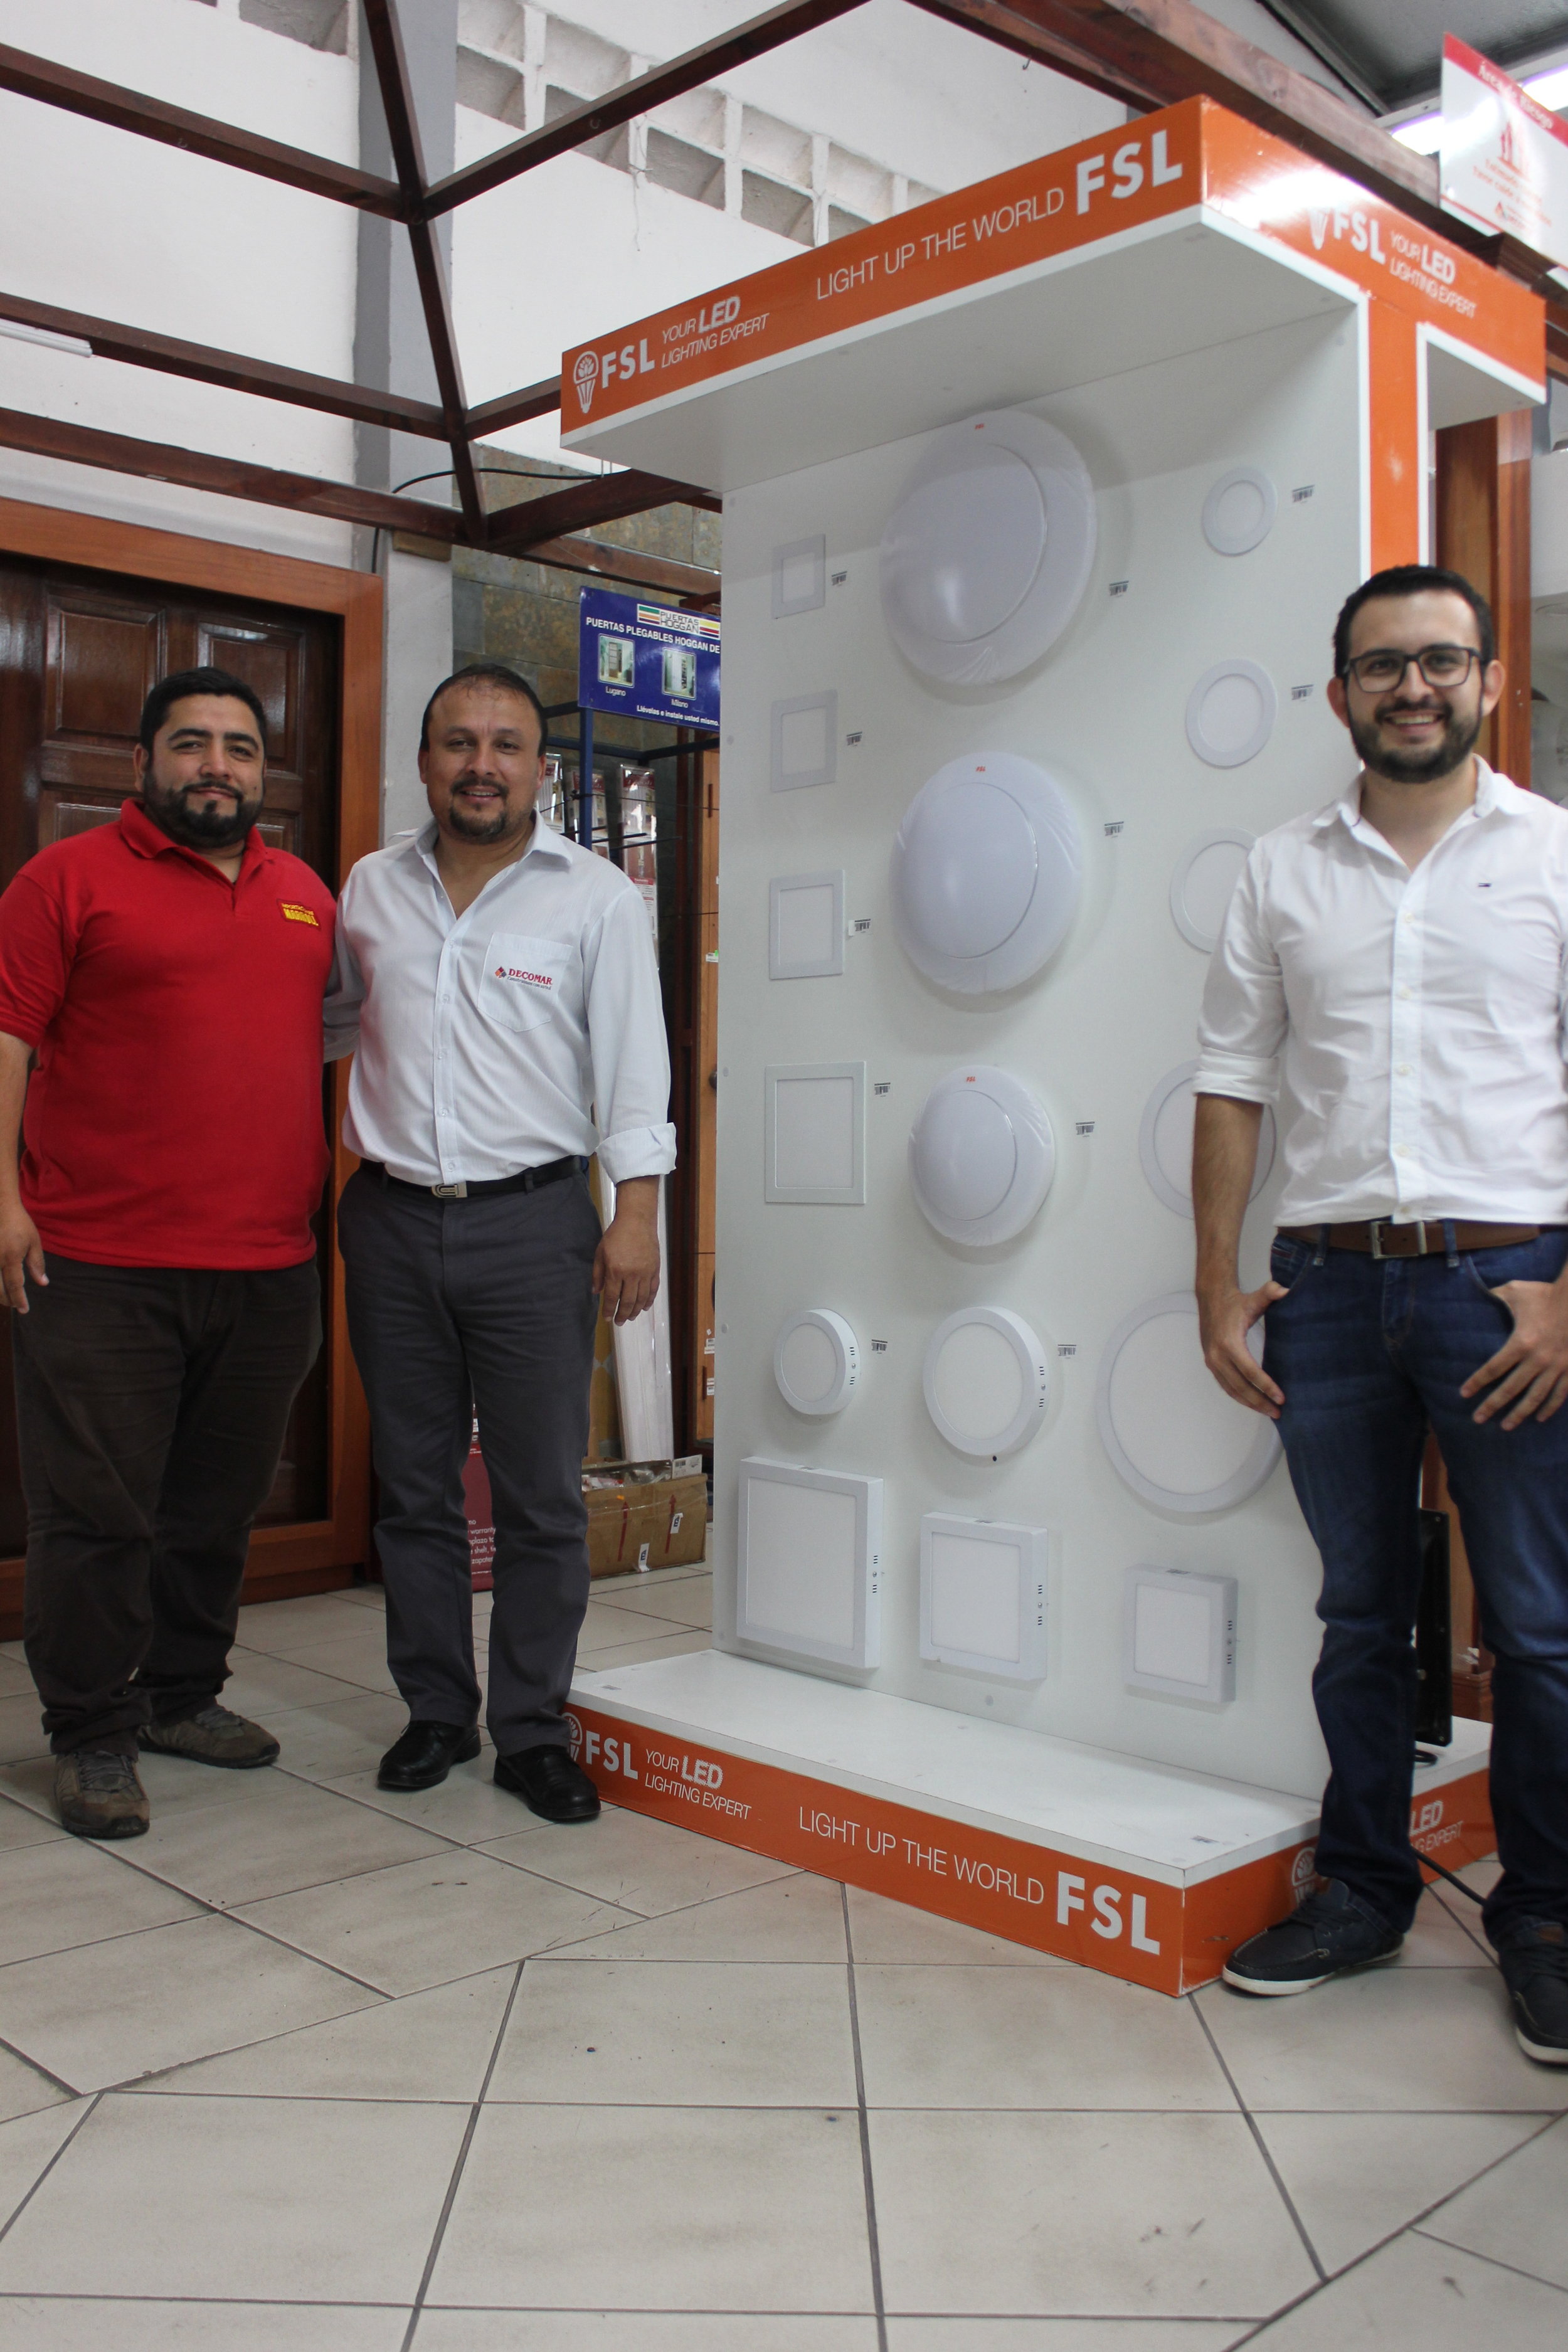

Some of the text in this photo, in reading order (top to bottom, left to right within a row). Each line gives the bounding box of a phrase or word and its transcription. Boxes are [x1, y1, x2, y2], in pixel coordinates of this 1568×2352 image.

[817, 129, 1183, 300] LIGHT UP THE WORLD FSL
[1333, 207, 1386, 265] FSL
[1389, 230, 1456, 285] YOUR LED
[1389, 258, 1477, 319] LIGHTING EXPERT
[661, 313, 770, 368] LIGHTING EXPERT
[662, 295, 741, 344] YOUR LED
[602, 338, 655, 389] FSL
[586, 617, 720, 654] PUERTAS PLEGABLES HOGGAN DE
[660, 612, 699, 626] PUERTAS
[660, 618, 699, 633] HOGGAN
[605, 686, 626, 697] Lugano
[671, 699, 689, 708] Milano
[508, 968, 553, 985] DECOMAR
[586, 1730, 638, 1780] FSL
[645, 1748, 724, 1789] YOUR LED
[645, 1772, 752, 1820] LIGHTING EXPERT
[1409, 1800, 1444, 1836] LED
[1425, 1820, 1464, 1851] EXPERT
[800, 1806, 1160, 1956] LIGHT UP THE WORLD FSL
